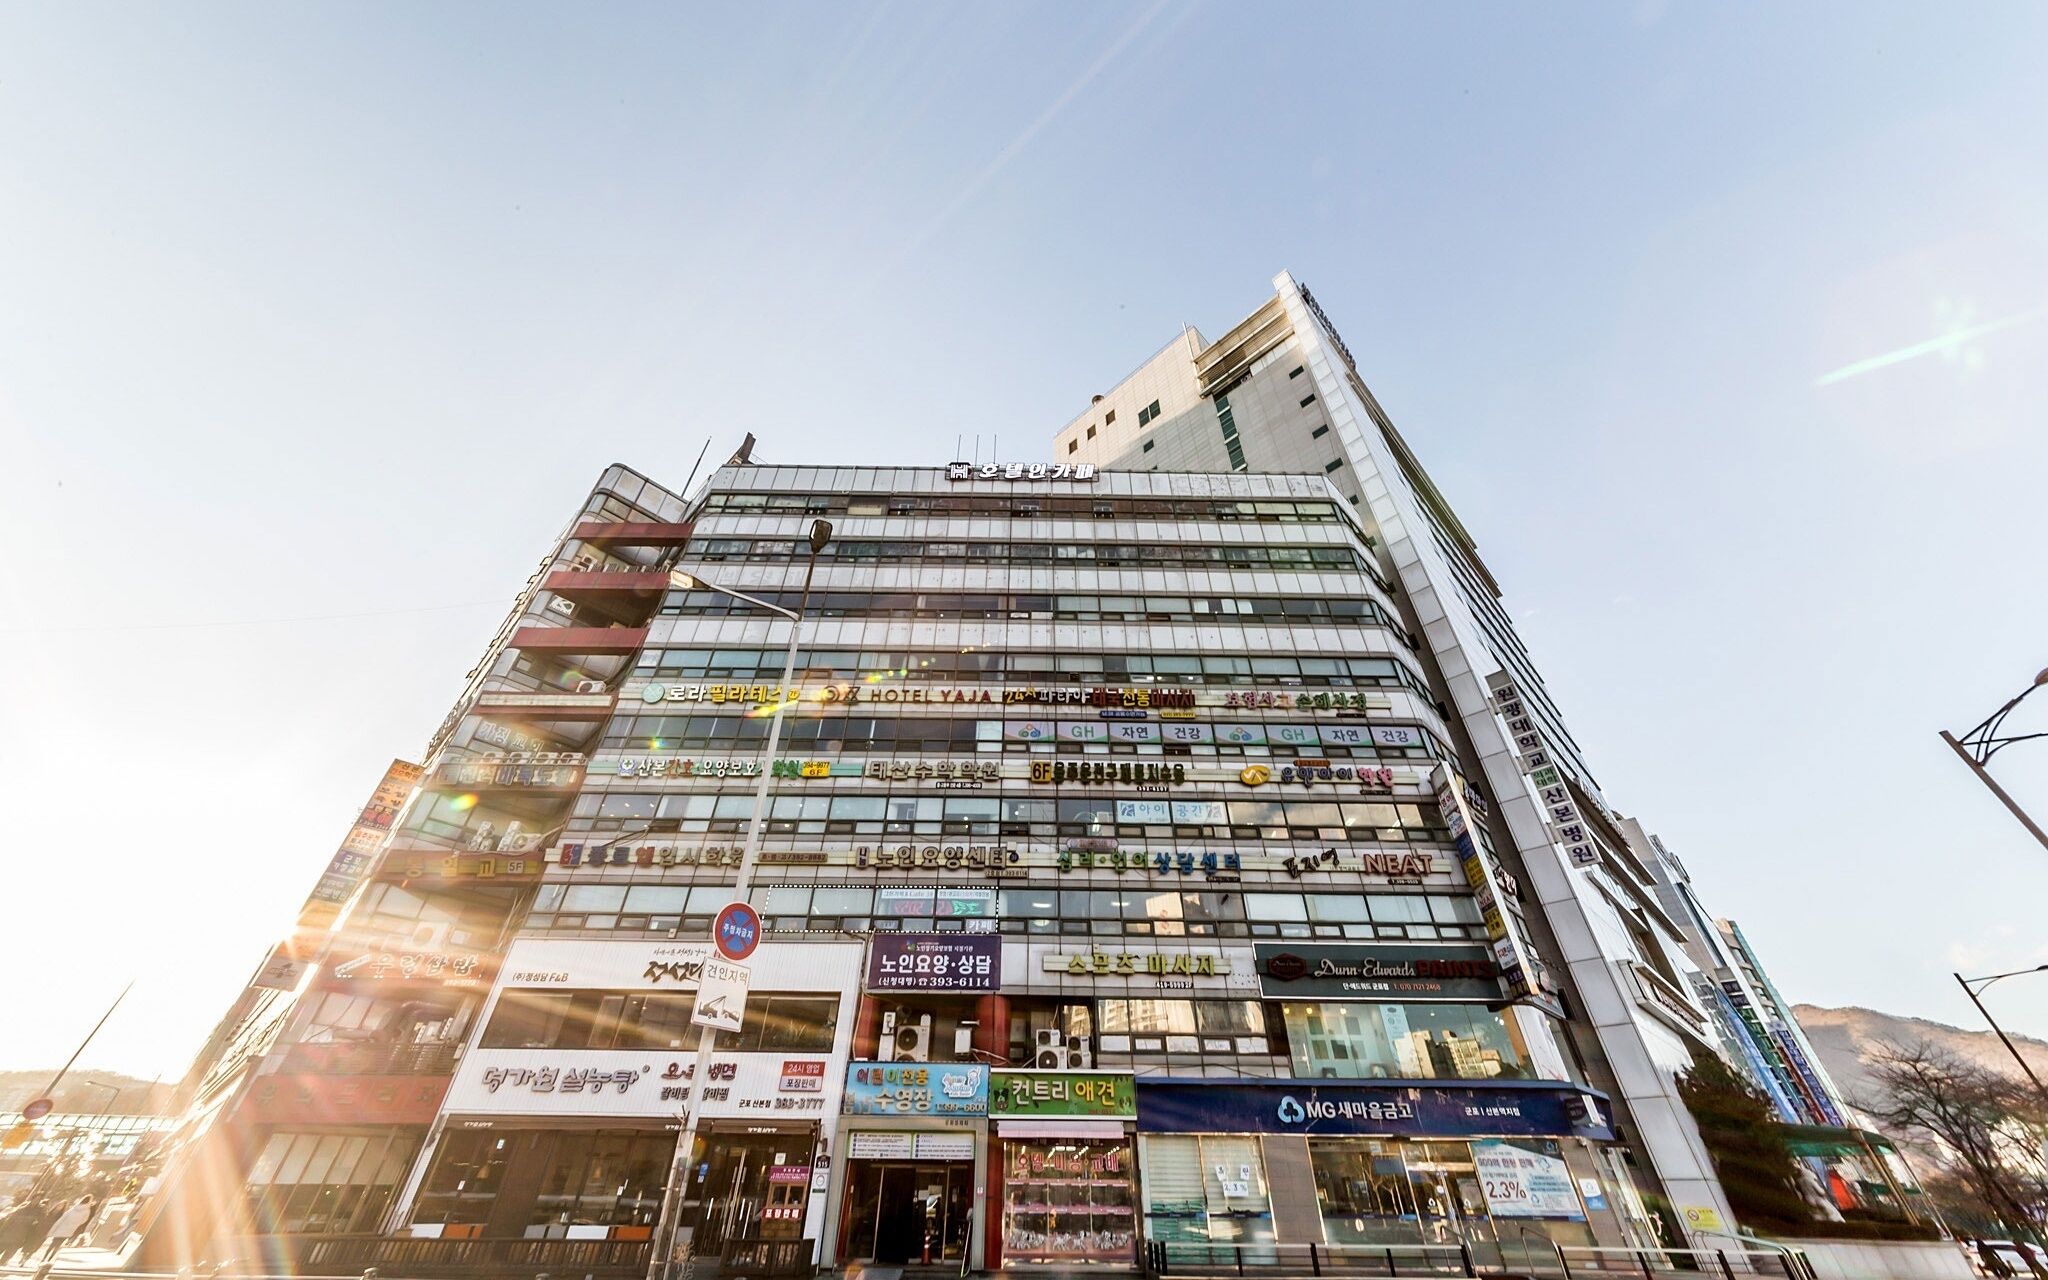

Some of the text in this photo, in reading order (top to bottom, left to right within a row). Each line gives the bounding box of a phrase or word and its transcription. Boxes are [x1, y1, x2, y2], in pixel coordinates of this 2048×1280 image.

[979, 463, 1095, 479] 호텔인카페
[872, 689, 992, 703] HOTEL YAJA
[1071, 726, 1200, 739] GH 자연 건강
[1281, 729, 1408, 743] GH 자연 건강
[1497, 688, 1547, 768] 원광대학교
[870, 760, 1000, 781] 태산수학학원
[1032, 763, 1051, 779] 6F
[1545, 787, 1595, 863] 산본병원
[509, 862, 522, 872] 5F
[875, 846, 1008, 871] 노인요양센터
[1363, 854, 1432, 874] NEAT
[723, 923, 753, 939] 주정차금지
[968, 920, 993, 930] 카페
[880, 954, 992, 974] 노인요양·상담
[1069, 953, 1215, 976] 스포츠 마사지
[1314, 957, 1416, 978] Dunn-Edwards
[549, 972, 569, 982] F&B
[707, 963, 749, 985] 견인지역
[878, 976, 990, 987] (신청대행) 393-6114
[788, 1064, 820, 1074] 24시 영업
[857, 1068, 928, 1086] 어린이전용
[874, 1087, 933, 1112] 수영장
[1012, 1079, 1116, 1106] 컨트리 애견
[1486, 1181, 1527, 1199] 2.3%
[765, 1208, 800, 1219] 포장판매
